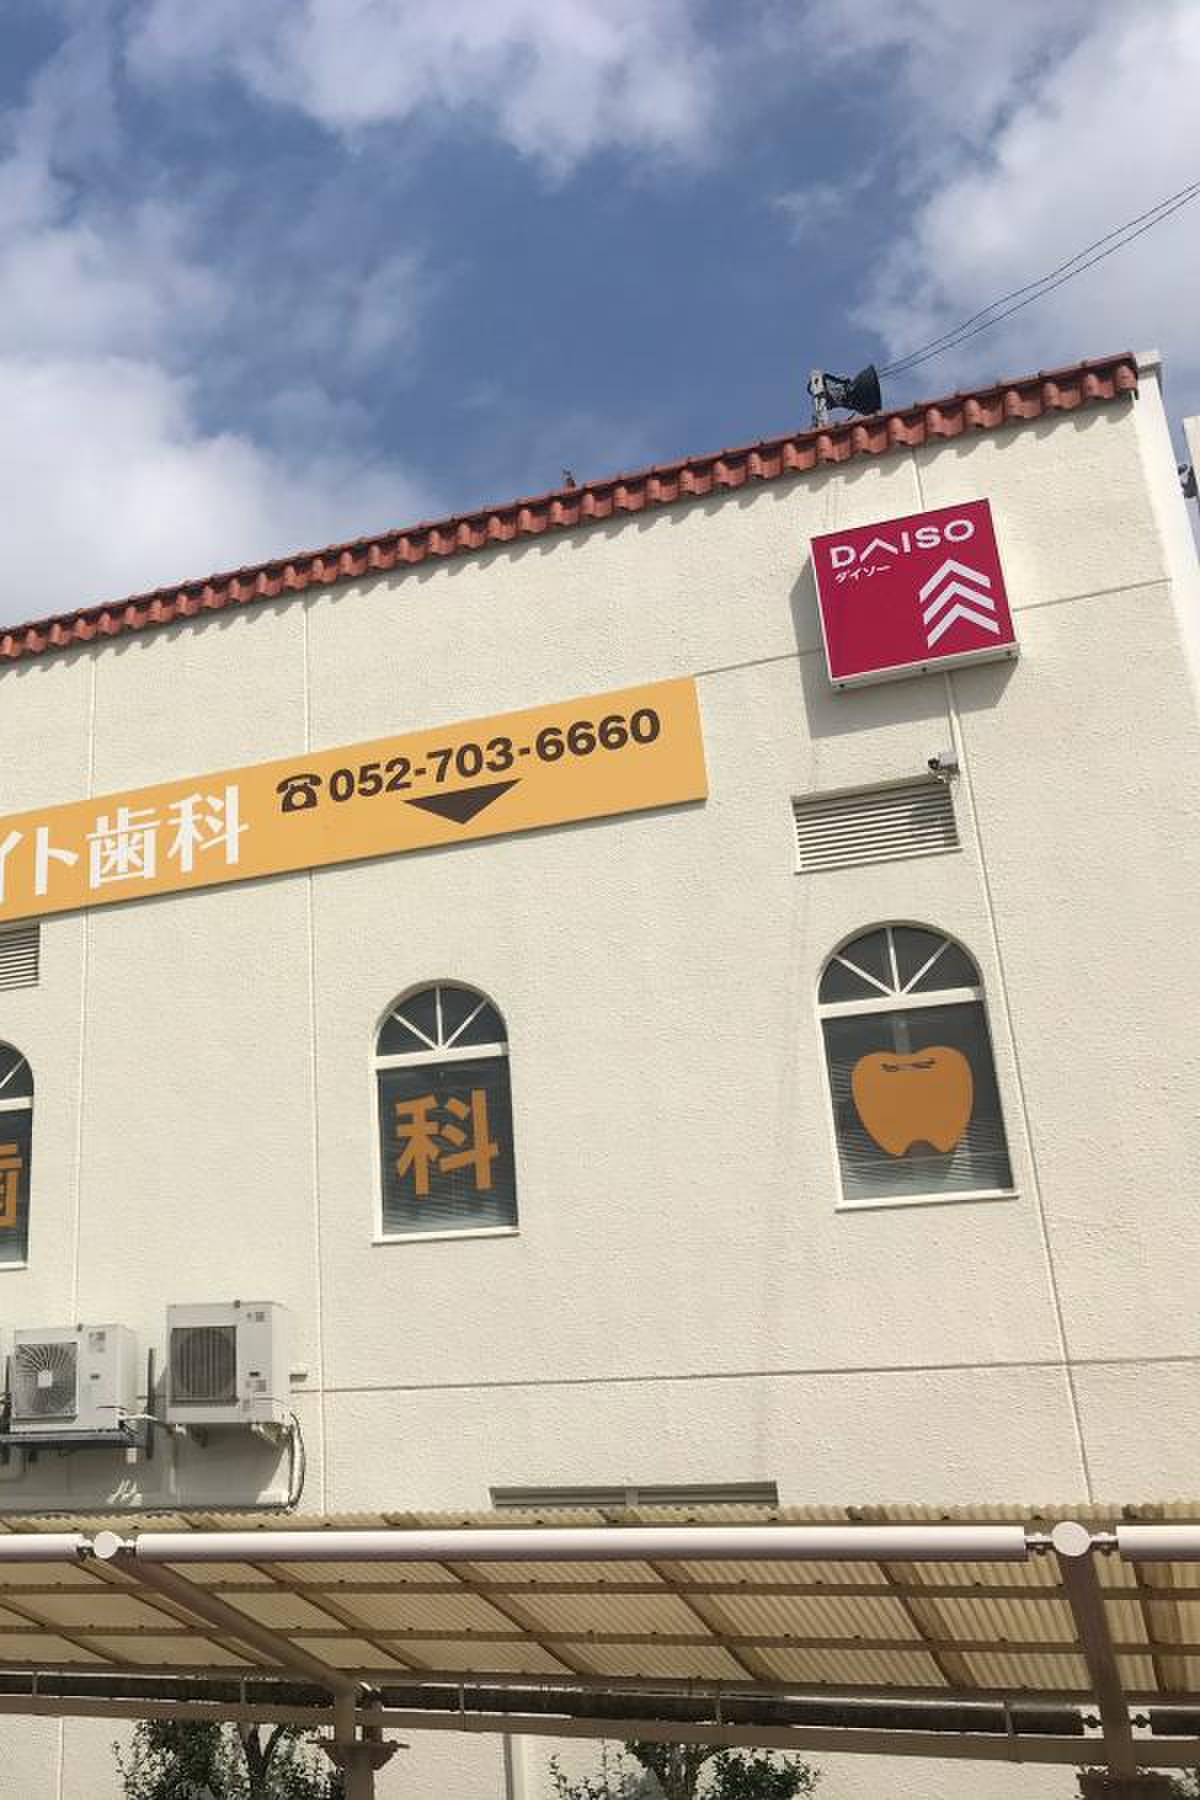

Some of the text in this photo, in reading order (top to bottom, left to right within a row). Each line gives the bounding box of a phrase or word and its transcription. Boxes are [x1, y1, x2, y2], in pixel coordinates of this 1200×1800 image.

[829, 519, 975, 569] DAISO
[834, 563, 892, 584] ダイソー
[289, 708, 661, 802] 052-703-6660
[395, 1088, 500, 1196] 科
